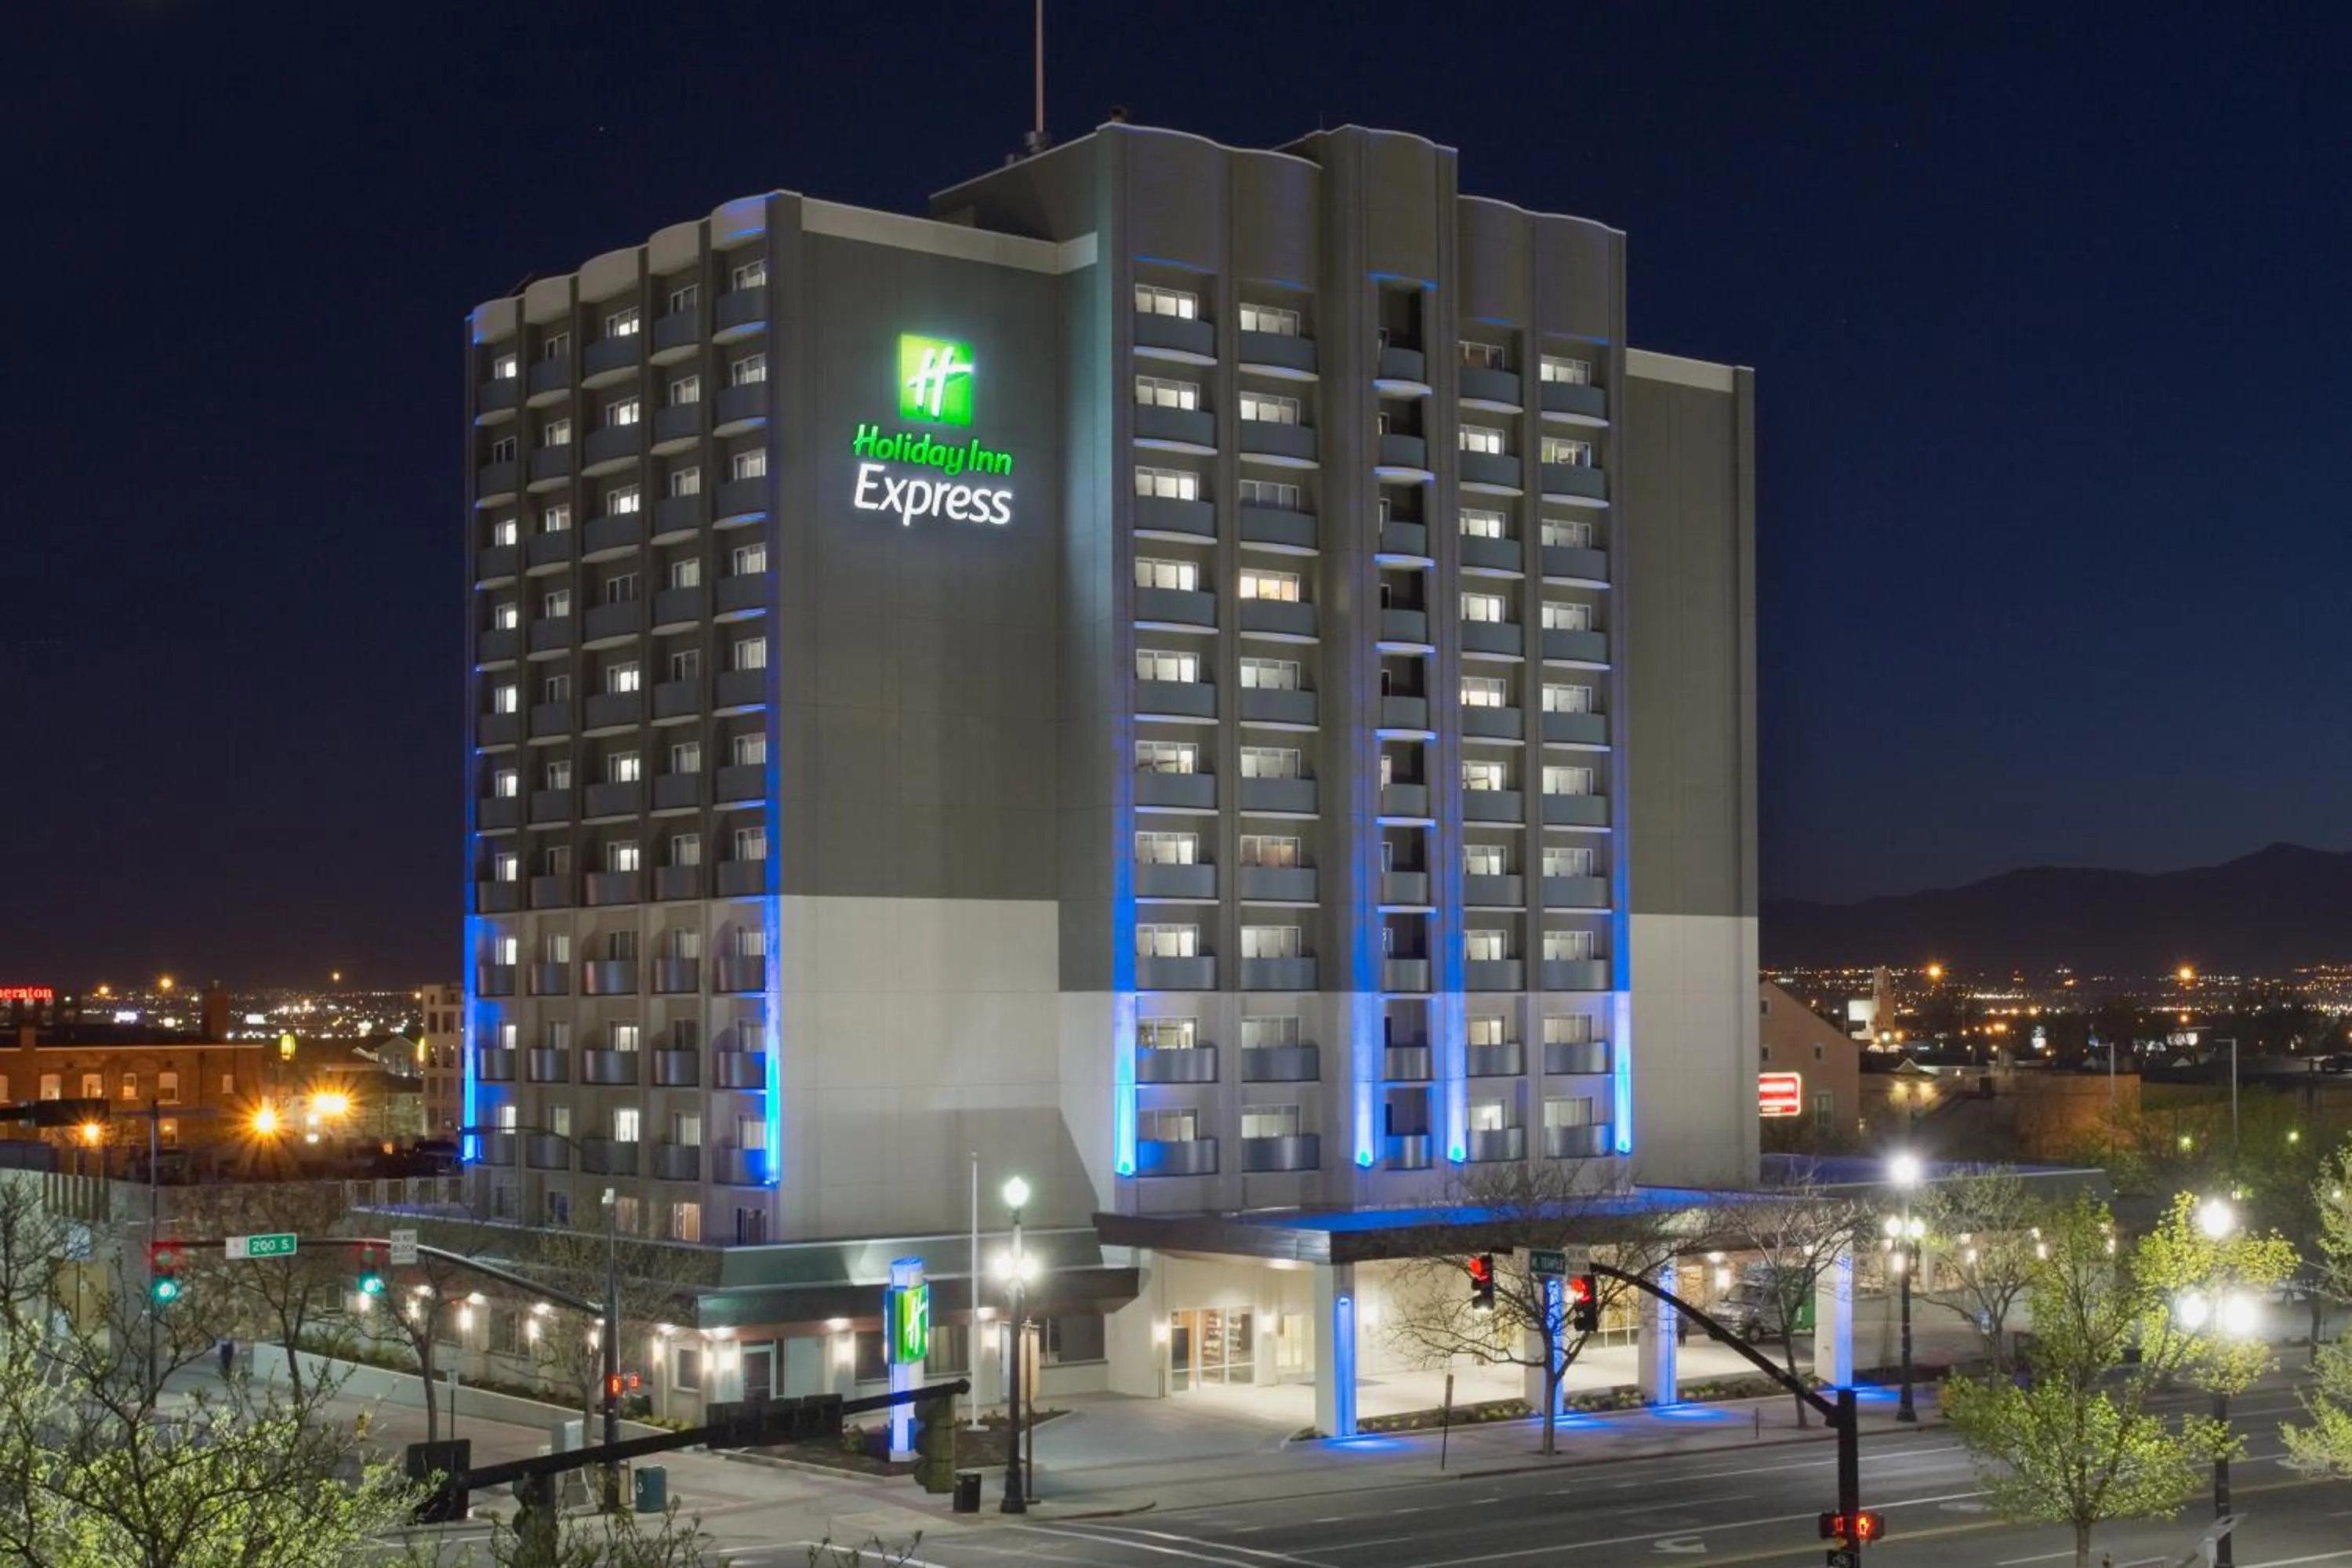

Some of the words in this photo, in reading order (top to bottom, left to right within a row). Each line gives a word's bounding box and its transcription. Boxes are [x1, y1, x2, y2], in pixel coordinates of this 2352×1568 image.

[853, 423, 965, 476] Holiday
[968, 438, 1012, 475] Inn
[854, 463, 1013, 526] Express
[252, 1240, 276, 1252] 200
